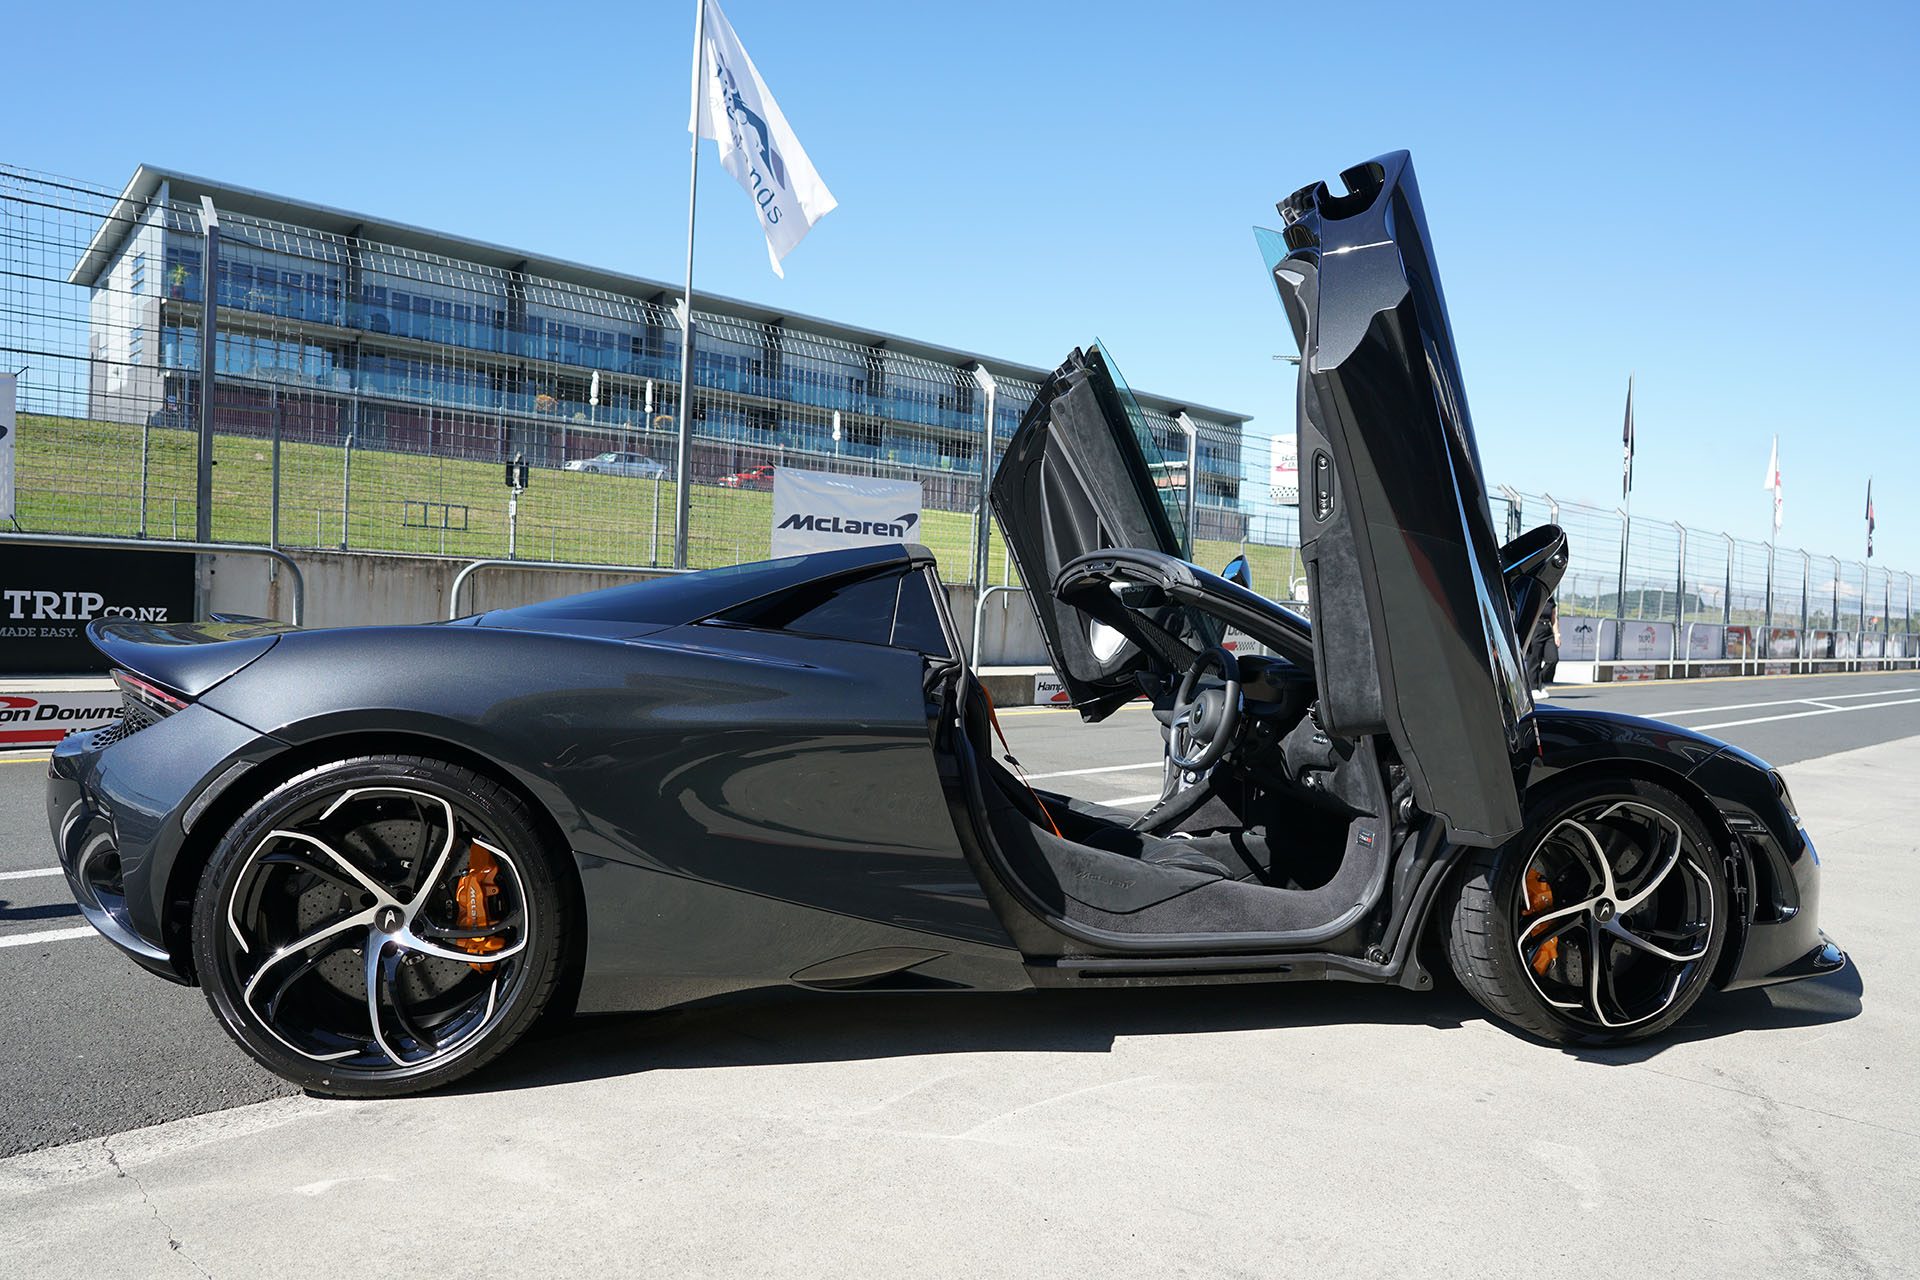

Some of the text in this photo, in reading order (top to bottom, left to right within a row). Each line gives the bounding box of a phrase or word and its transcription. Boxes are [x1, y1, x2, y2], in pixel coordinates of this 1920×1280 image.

[777, 513, 904, 538] McLaren
[40, 627, 78, 638] EASY.
[1037, 681, 1064, 692] Hamp
[35, 704, 125, 722] Downs
